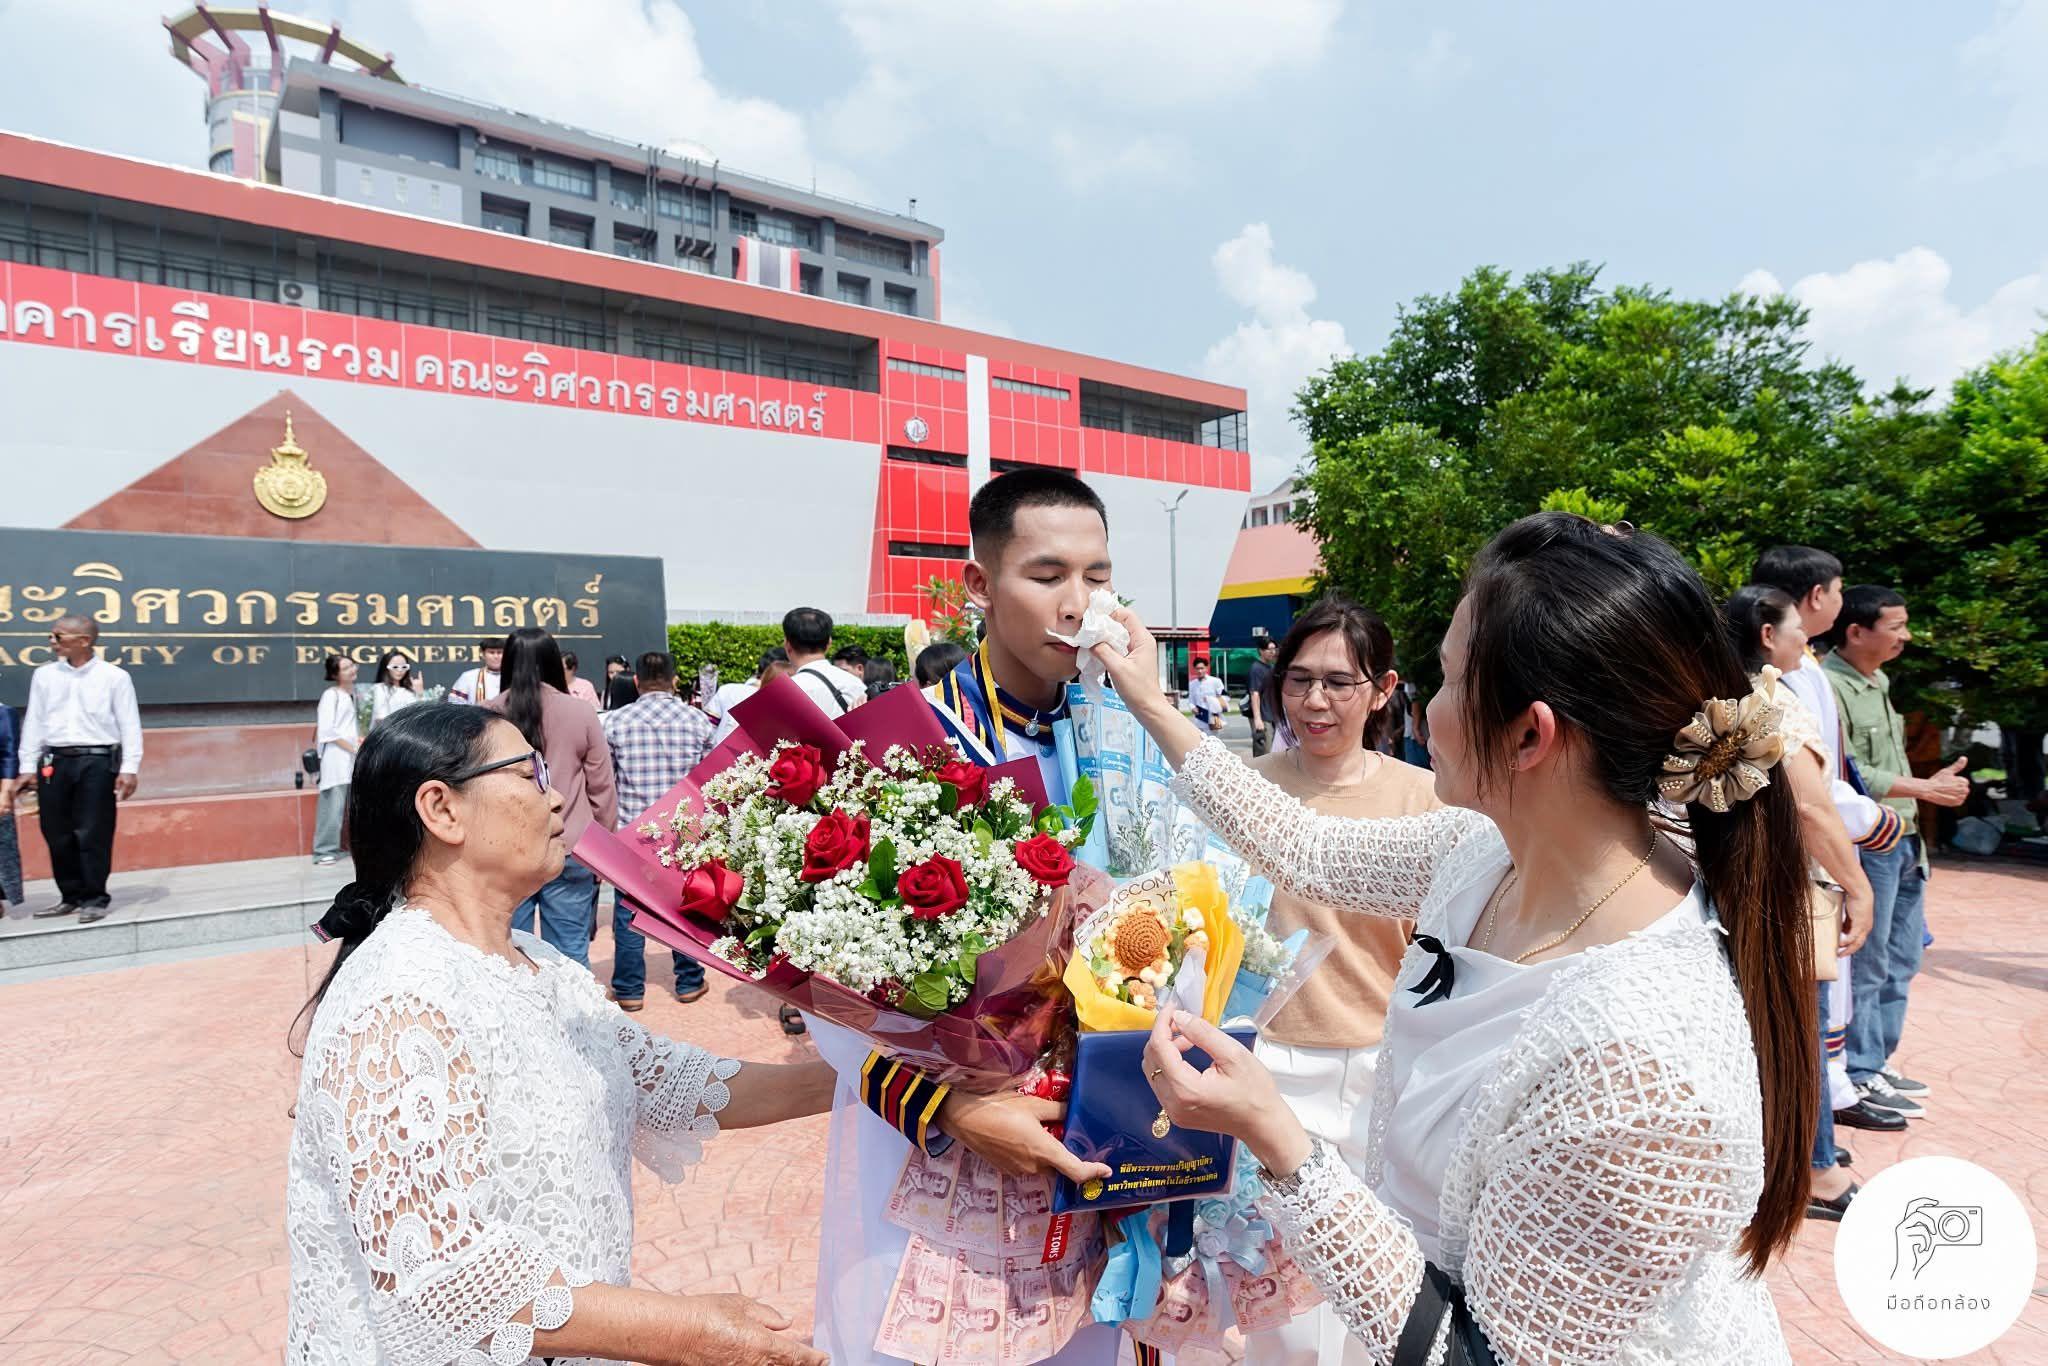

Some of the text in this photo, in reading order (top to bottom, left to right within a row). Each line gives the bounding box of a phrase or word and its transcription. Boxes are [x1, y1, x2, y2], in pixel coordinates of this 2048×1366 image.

[0, 300, 826, 432] คารเรียนรวม คณะวิศวกรรมศาสตร์
[212, 646, 270, 664] OF
